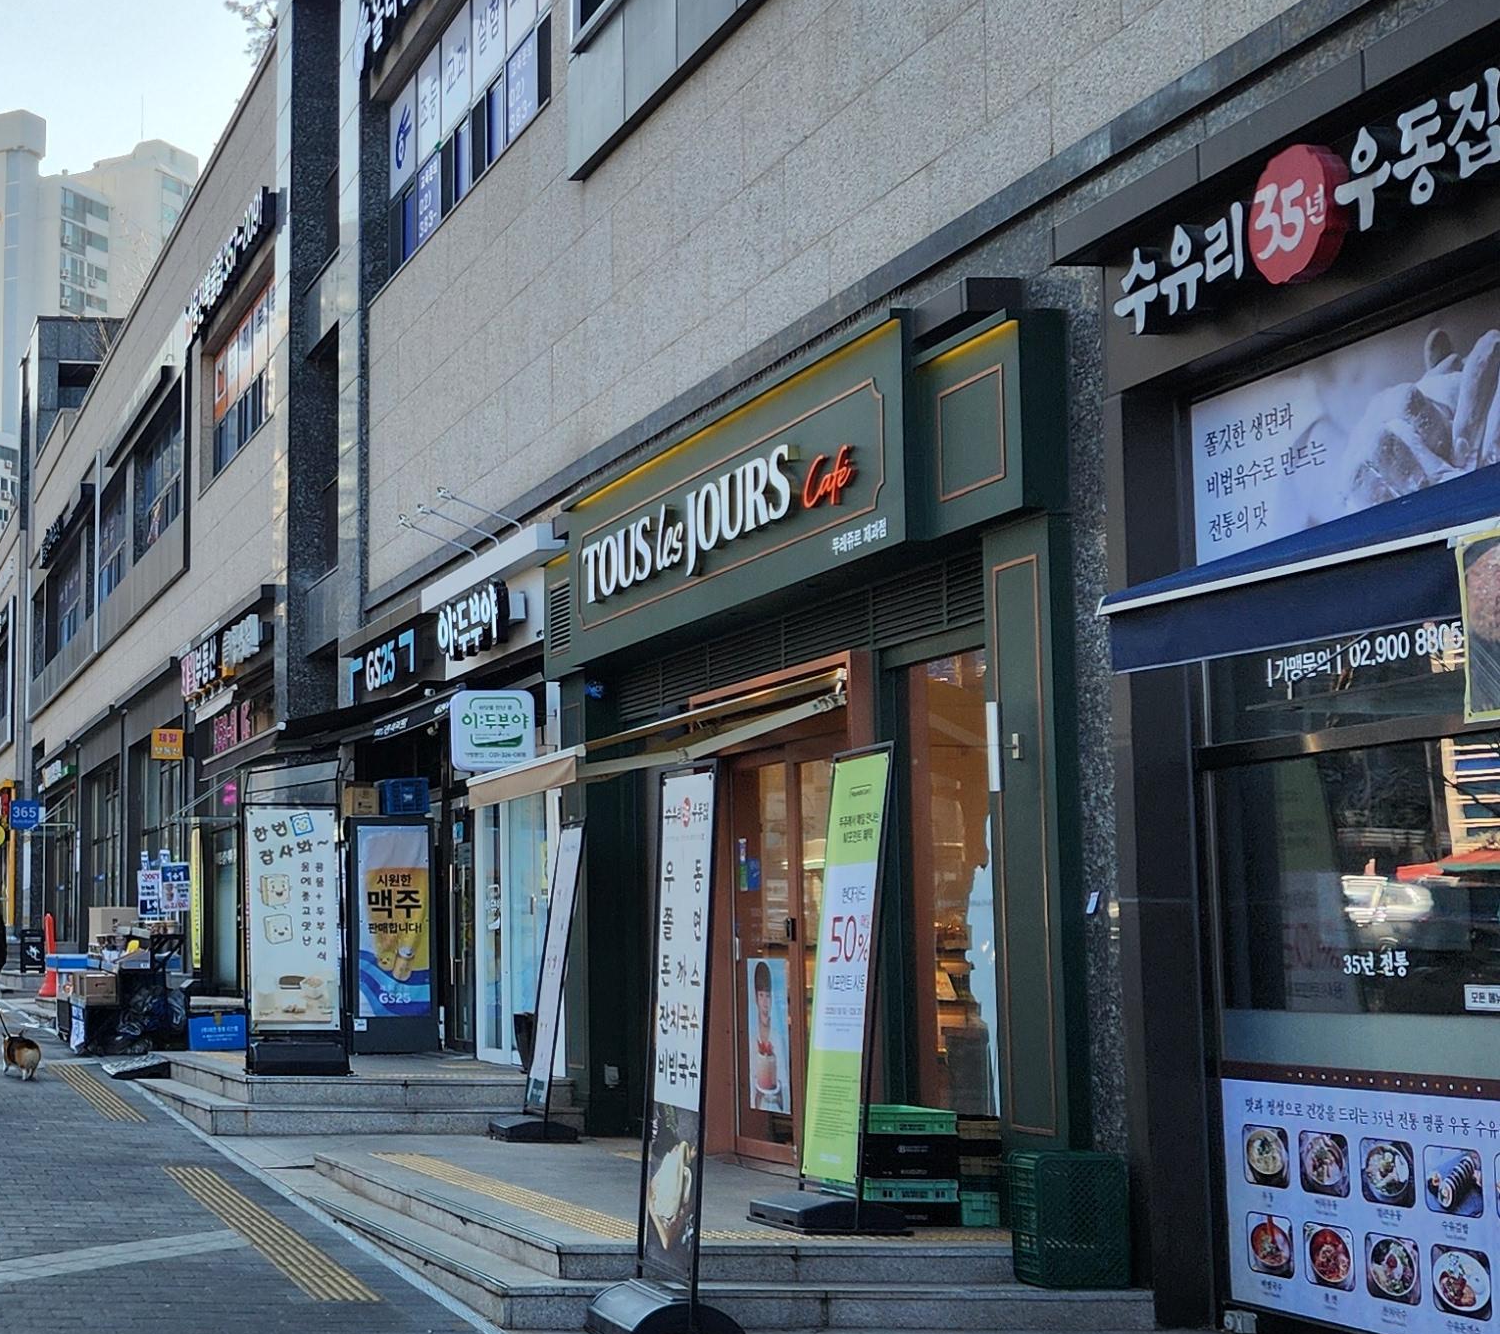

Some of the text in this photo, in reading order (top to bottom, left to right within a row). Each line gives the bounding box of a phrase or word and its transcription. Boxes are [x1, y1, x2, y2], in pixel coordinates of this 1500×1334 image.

[1113, 67, 1500, 336] 수유리 35년 우동집
[1203, 402, 1294, 458] 쫄깃한 생면과
[1205, 440, 1328, 499] 비법육수로 만드는
[582, 515, 651, 604] TOUS
[655, 503, 685, 571] les
[685, 443, 791, 577] JOURS
[1207, 500, 1269, 543] 전통의 맛
[365, 639, 397, 692] GS25
[12, 805, 37, 819] 365
[376, 872, 413, 888] 시원한
[366, 889, 423, 919] 맥주
[367, 922, 423, 935] 판매합니다!
[828, 915, 870, 963] 50%
[1342, 947, 1410, 978] 35년 전통
[378, 992, 412, 1005] GS25
[658, 1000, 700, 1039] 잔치국수
[658, 1047, 699, 1089] 비빔국수
[1266, 1098, 1303, 1118] 정성으로
[1306, 1103, 1336, 1123] 건강을
[1338, 1107, 1368, 1126] 드리는
[1371, 1109, 1395, 1129] 35년
[1398, 1111, 1420, 1131] 전통
[1422, 1114, 1444, 1134] 명품
[1447, 1117, 1471, 1137] 우동
